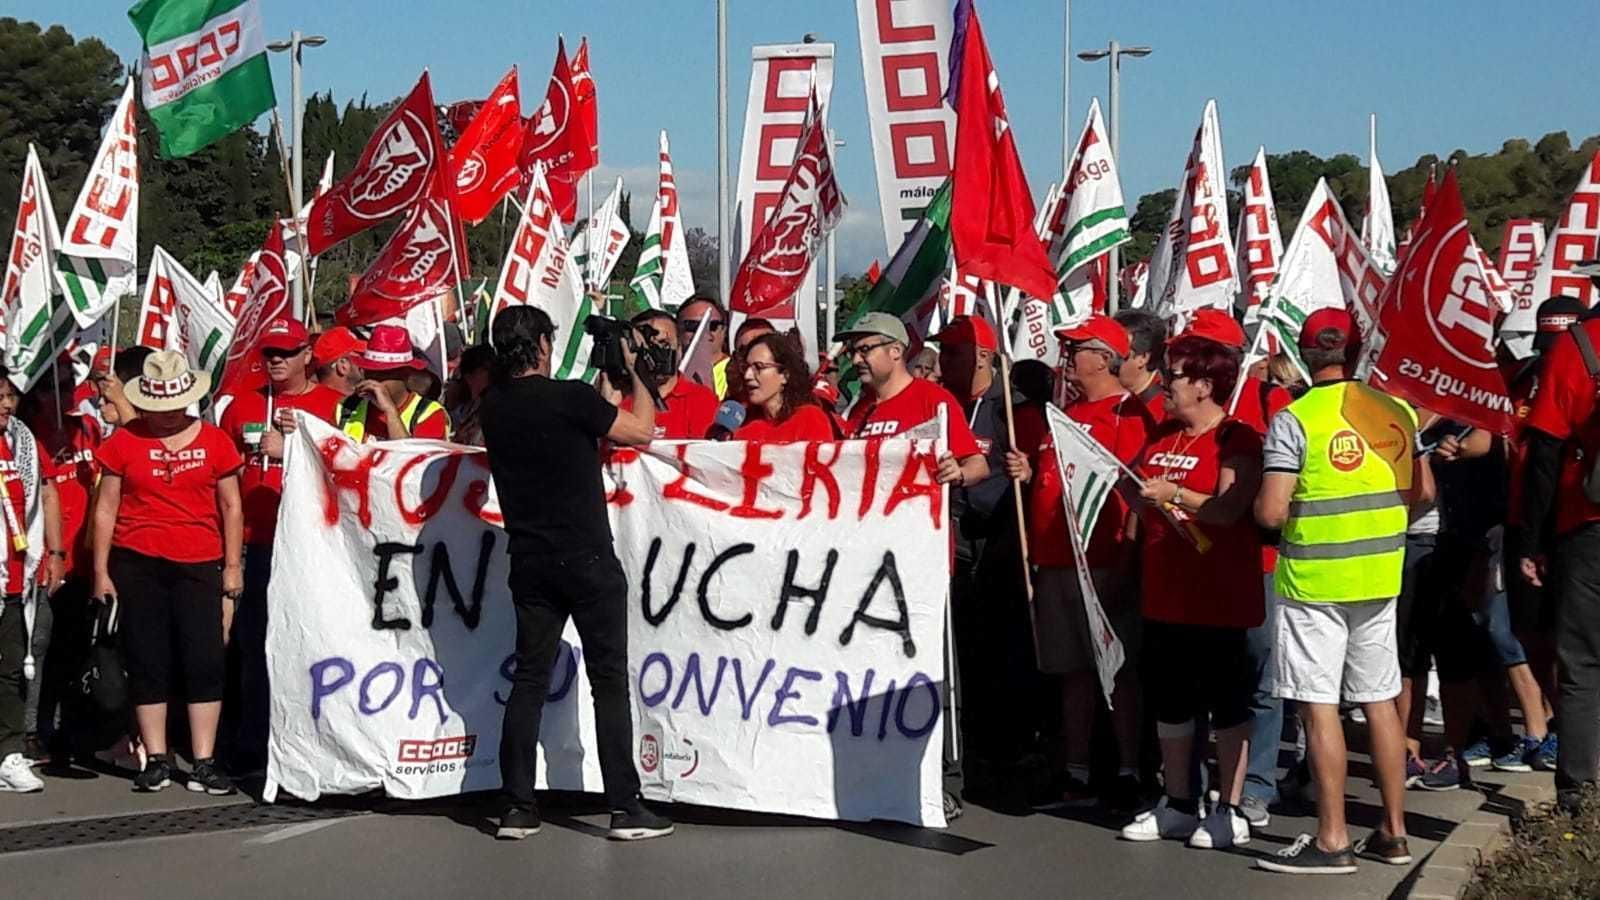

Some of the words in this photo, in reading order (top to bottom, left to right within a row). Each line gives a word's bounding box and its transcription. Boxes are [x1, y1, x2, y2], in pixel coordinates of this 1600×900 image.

[900, 186, 935, 198] mála
[1022, 296, 1048, 358] álaga
[371, 530, 496, 631] EN
[641, 536, 917, 659] UCHA
[310, 656, 449, 724] POR
[638, 651, 941, 742] ONVENIO
[395, 761, 456, 775] servicios
